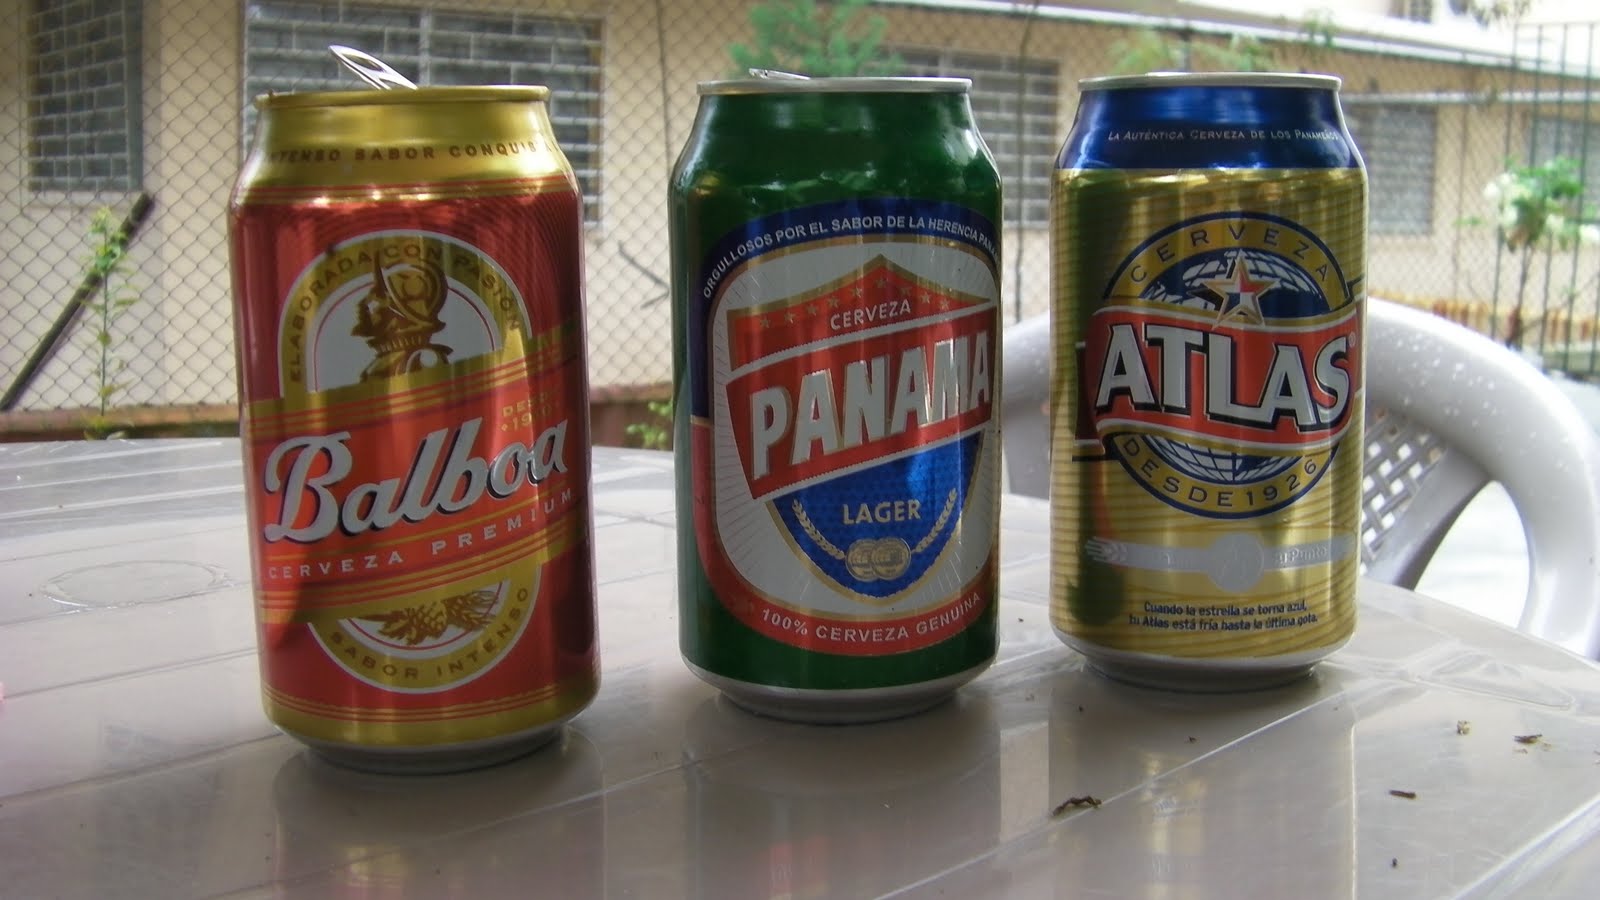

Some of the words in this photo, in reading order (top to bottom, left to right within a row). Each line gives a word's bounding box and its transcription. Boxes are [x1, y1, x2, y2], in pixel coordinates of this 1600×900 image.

[1108, 130, 1120, 141] LA
[1190, 129, 1246, 141] CERVEZA
[1250, 130, 1266, 140] DE
[1270, 130, 1291, 140] LOS
[703, 232, 774, 299] ORGULLOSOS
[775, 224, 807, 243] POR
[809, 221, 829, 235] EL
[831, 215, 883, 232] SABOR
[886, 215, 906, 228] DE
[908, 215, 926, 229] LA
[928, 217, 979, 241] HERENCIA
[1130, 223, 1329, 284] CERVEZA
[289, 250, 373, 383] ELABORADA
[383, 243, 443, 260] CON
[829, 298, 912, 331] CERVEZA
[750, 330, 991, 480] PANAMA
[1096, 322, 1352, 433] ATLAS
[263, 417, 569, 544] Balboa
[1123, 437, 1234, 508] DESDE
[1246, 458, 1318, 507] 1926
[268, 550, 404, 580] CERVEZA
[431, 487, 573, 556] PREMIUM
[842, 498, 922, 525] LAGER
[330, 630, 419, 680] SABOR
[436, 587, 530, 678] INTENSO
[762, 608, 808, 636] 100%
[815, 624, 910, 643] CERVEZA
[915, 592, 982, 636] GENUINA
[1142, 615, 1170, 629] Atlas
[1172, 618, 1196, 631] está
[1221, 619, 1251, 631] hasta
[1253, 618, 1263, 629] la
[1144, 601, 1184, 615] Cuando
[1186, 604, 1196, 616] la
[1199, 604, 1240, 616] estrella
[1242, 605, 1255, 616] se
[1258, 604, 1285, 615] torna
